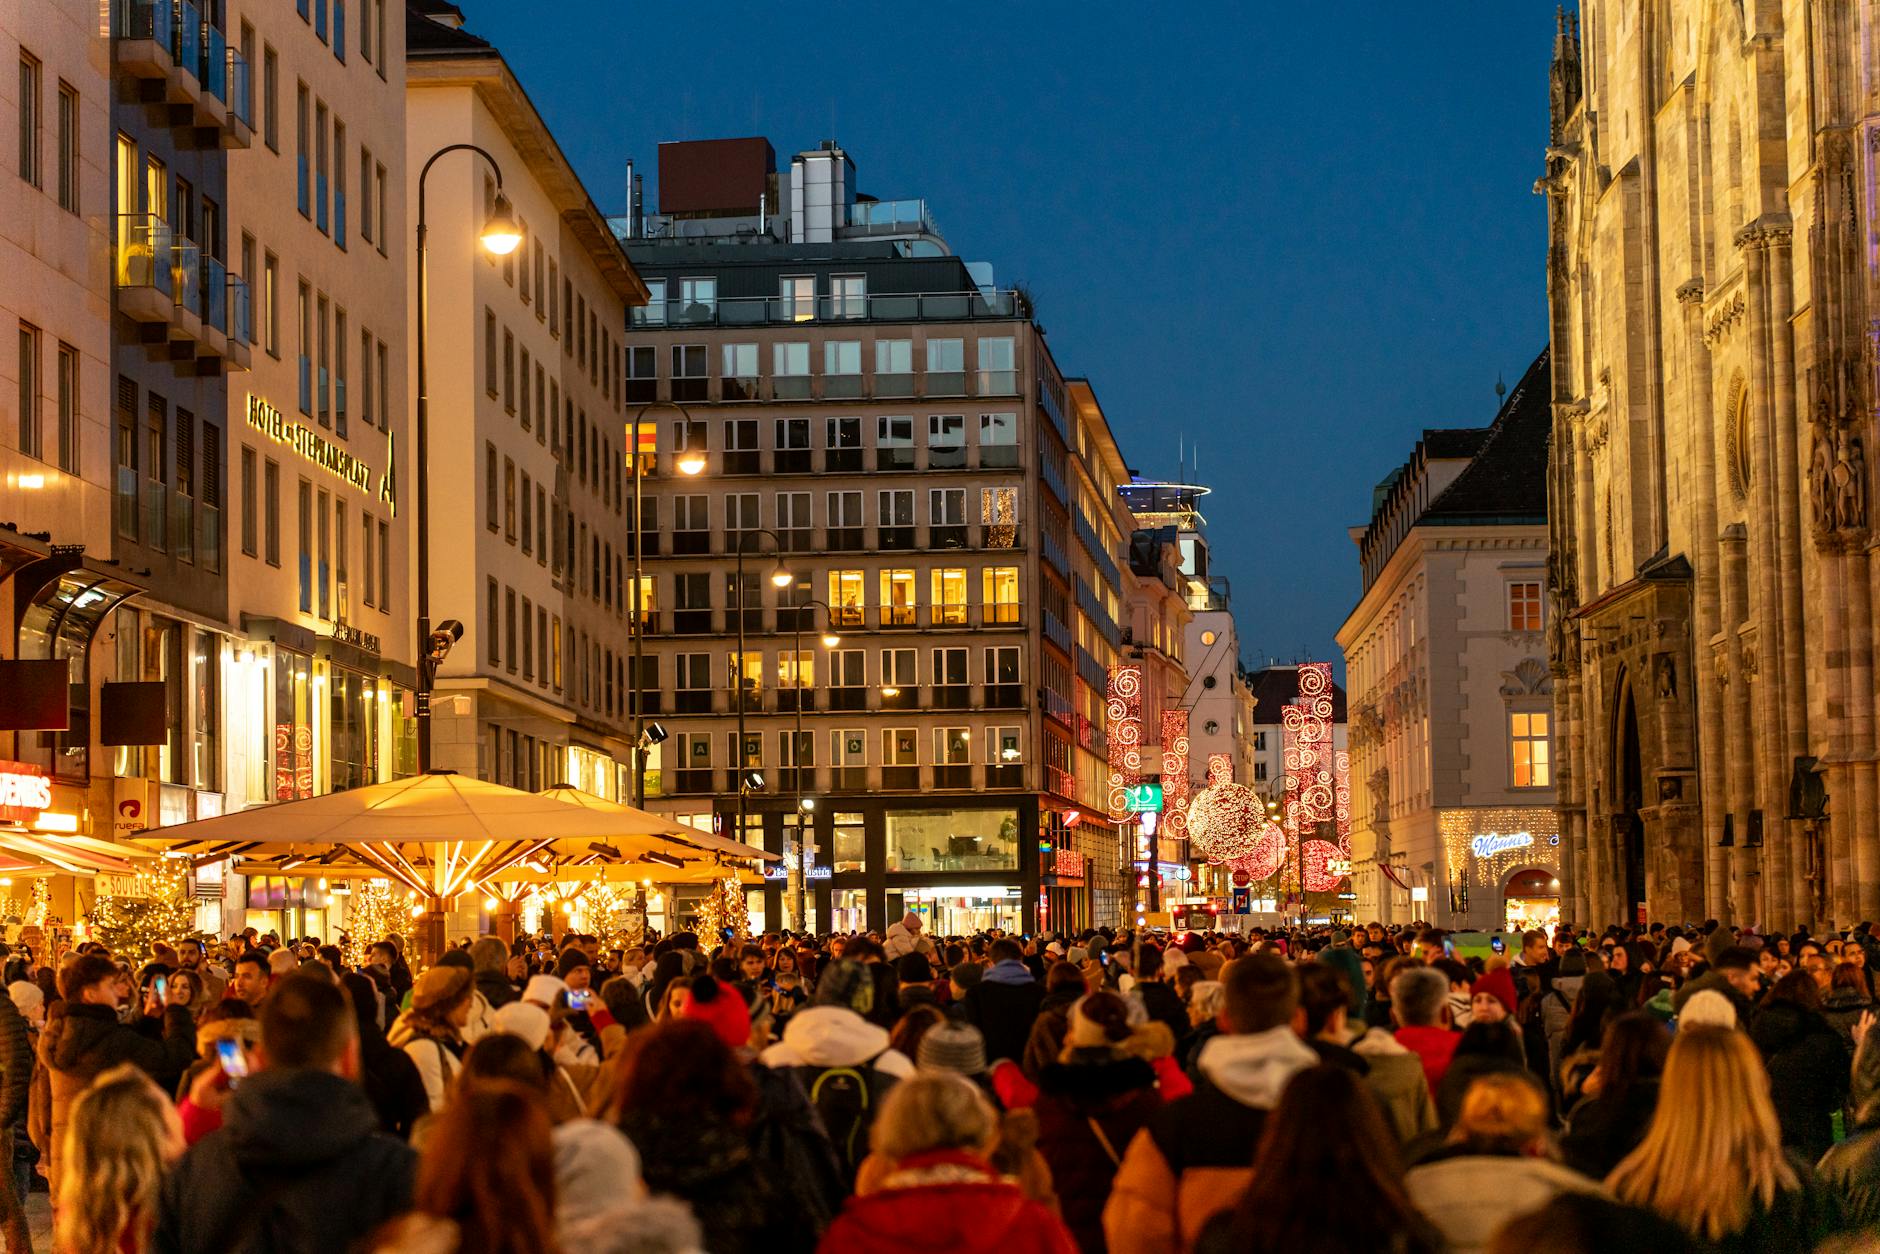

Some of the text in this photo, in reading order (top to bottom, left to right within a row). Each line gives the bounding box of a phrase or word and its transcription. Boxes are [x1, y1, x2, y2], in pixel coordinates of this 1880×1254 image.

[248, 394, 285, 441] HOTEL
[294, 424, 371, 492] STEPHANSPLATZ
[901, 740, 910, 750] K
[1473, 832, 1533, 857] Manner
[1233, 874, 1249, 882] STOP
